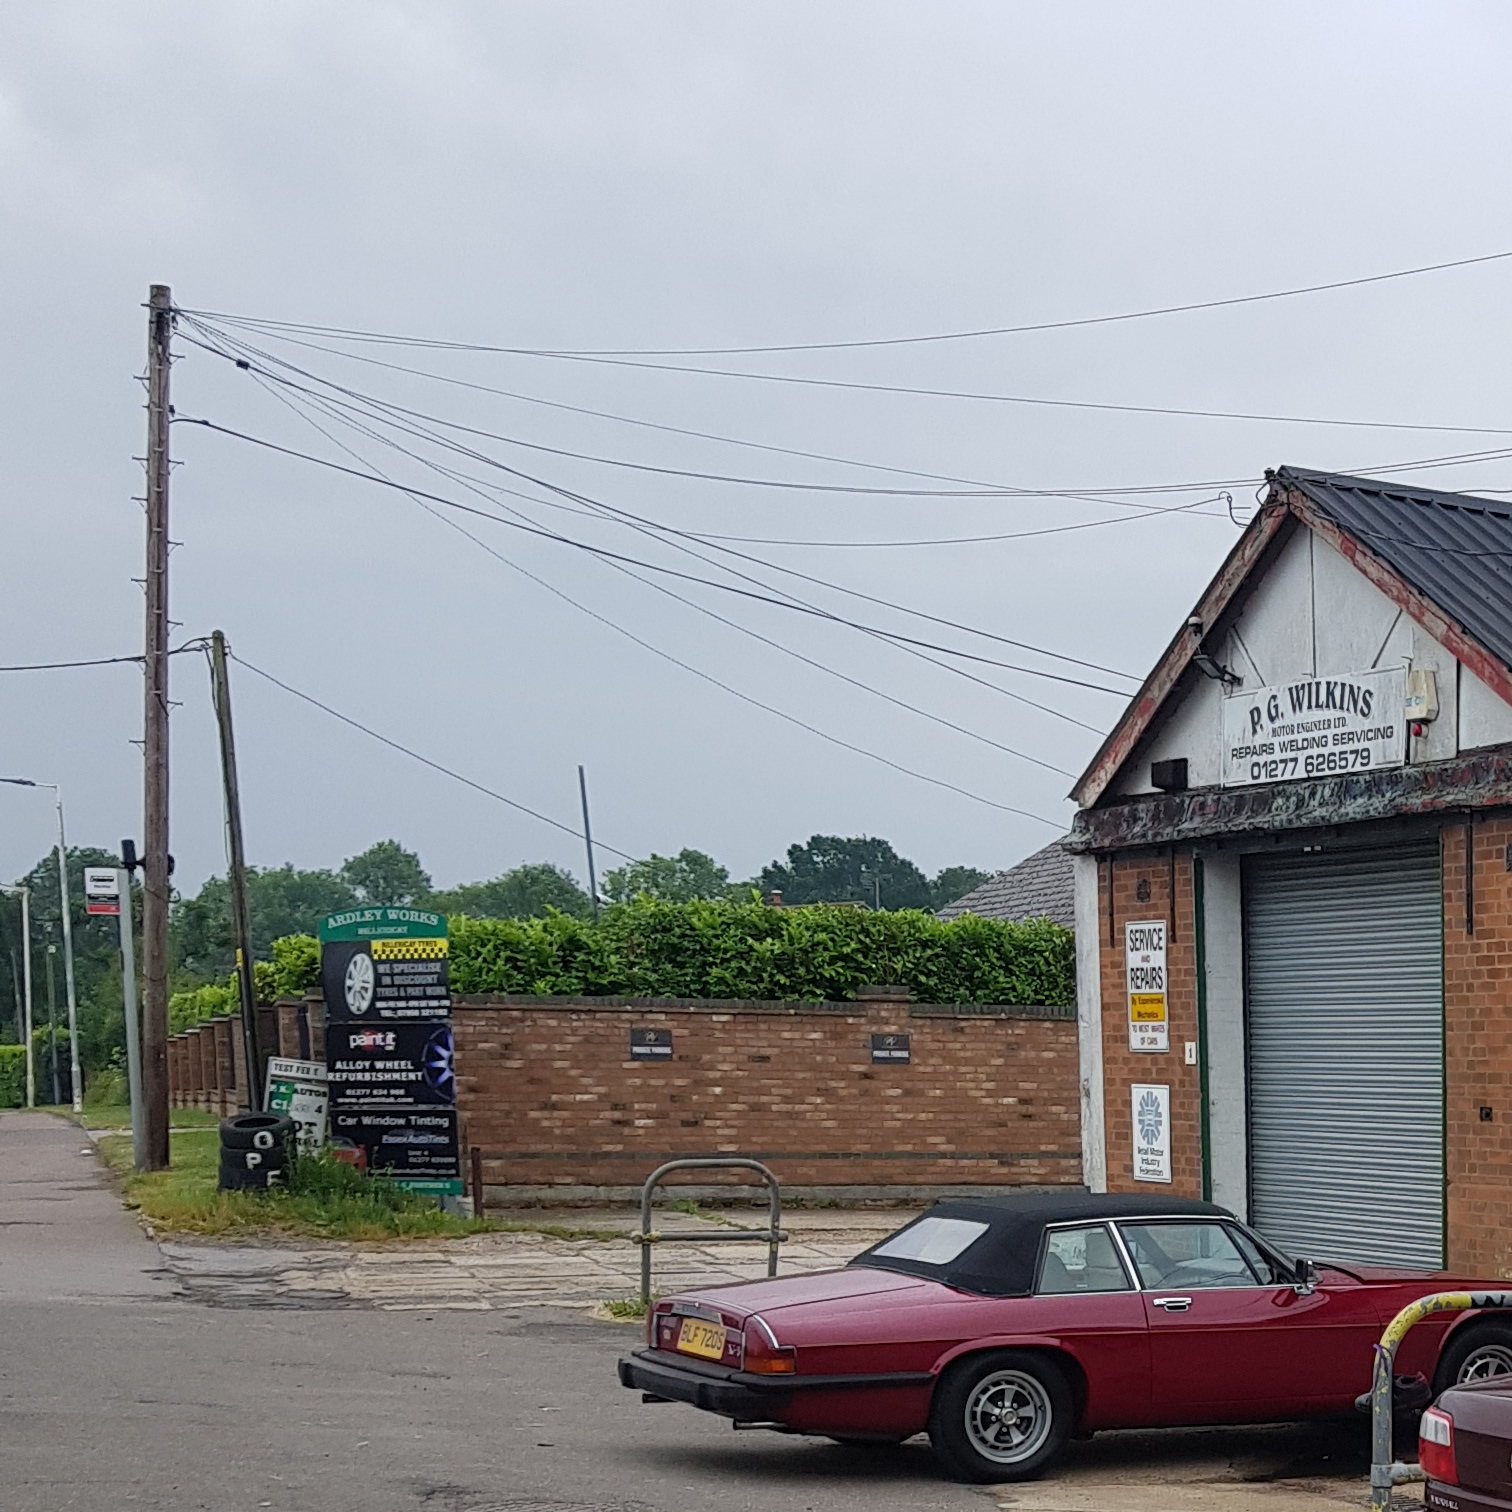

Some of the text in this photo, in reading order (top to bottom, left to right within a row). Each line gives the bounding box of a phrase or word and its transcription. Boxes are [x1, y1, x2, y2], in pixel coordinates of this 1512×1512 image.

[1249, 680, 1375, 737] P. G. WILKINS
[1271, 726, 1296, 739] MOTOR
[1296, 719, 1333, 735] ENGINEER
[1231, 725, 1394, 761] REPAIRS WELDING SERVICING
[1250, 747, 1371, 781] 01277 626579
[327, 908, 439, 929] ARDLEY WORKS
[1129, 928, 1163, 952] SERVICE
[1130, 966, 1163, 990] REPAIRS
[274, 1063, 294, 1073] TEST
[335, 1060, 414, 1070] ALLOY WHEEL
[327, 1071, 423, 1081] REFURBISHMENT
[314, 1104, 323, 1115] 4
[337, 1115, 450, 1128] Car Window Tinting
